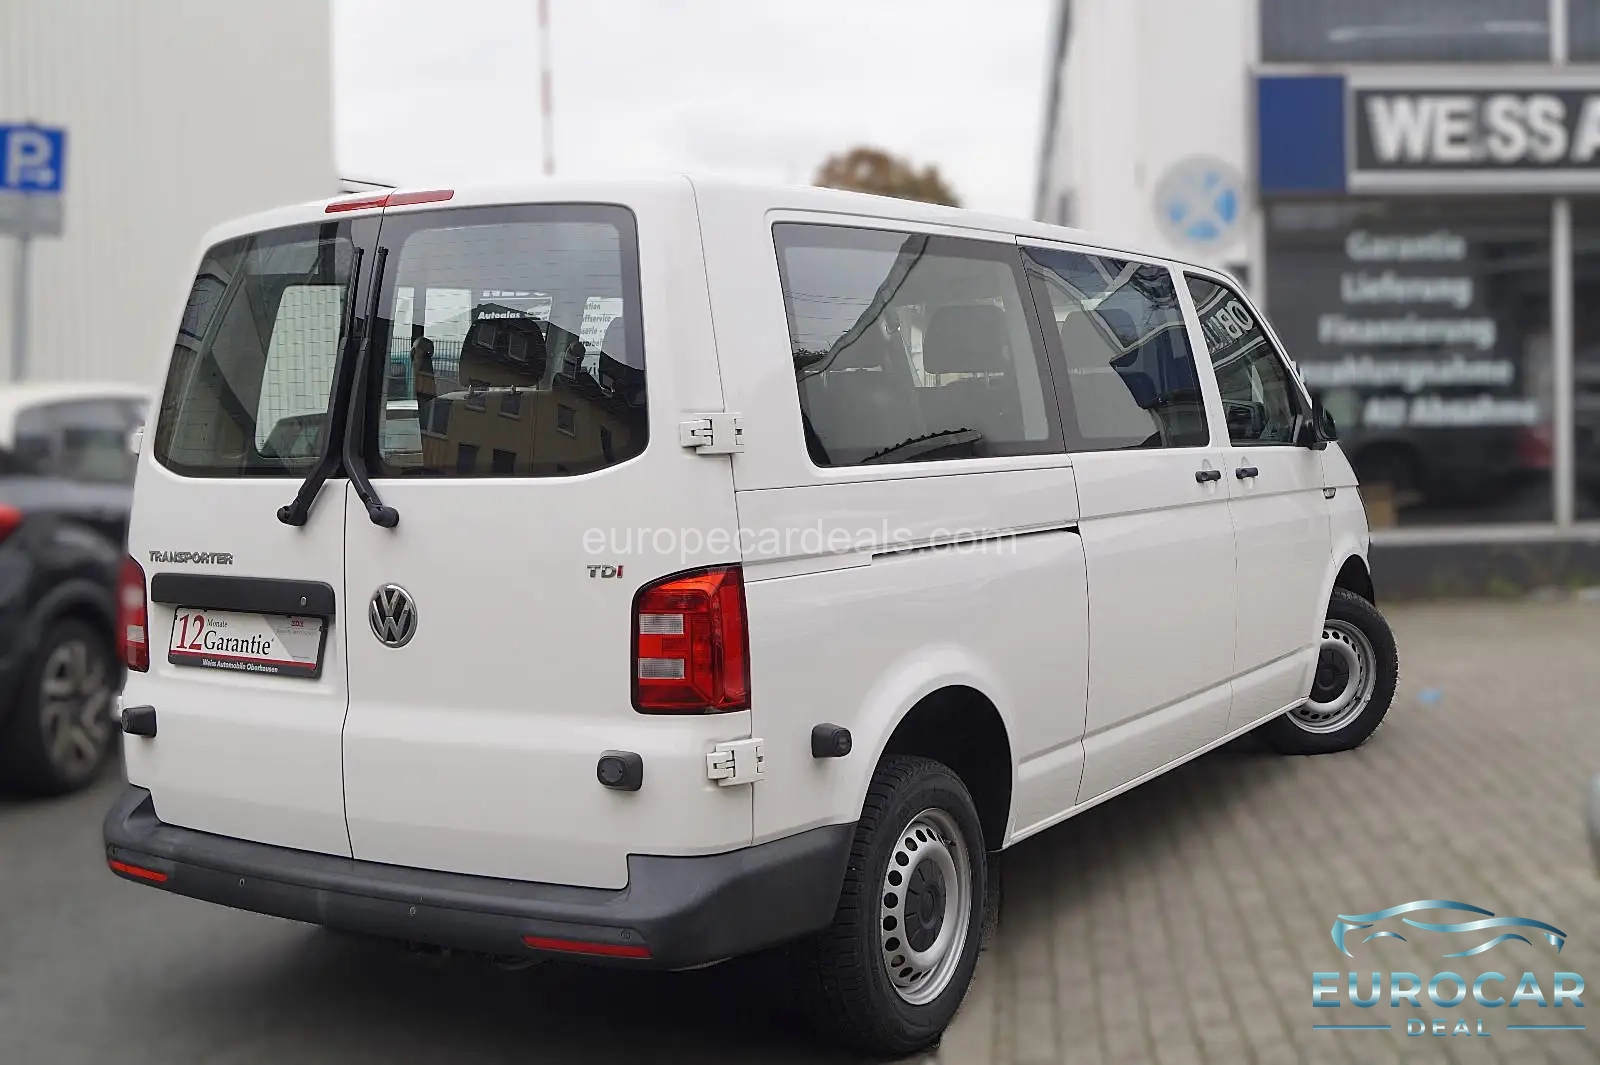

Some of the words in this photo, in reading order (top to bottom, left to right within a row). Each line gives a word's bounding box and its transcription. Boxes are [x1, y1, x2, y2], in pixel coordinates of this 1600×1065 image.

[6, 131, 53, 187] P
[149, 550, 233, 565] TRANSPORTER
[586, 564, 624, 579] TDI
[206, 618, 228, 628] Monate
[176, 614, 205, 650] 12
[217, 660, 246, 670] Automobile
[247, 663, 278, 673] Oberhausen
